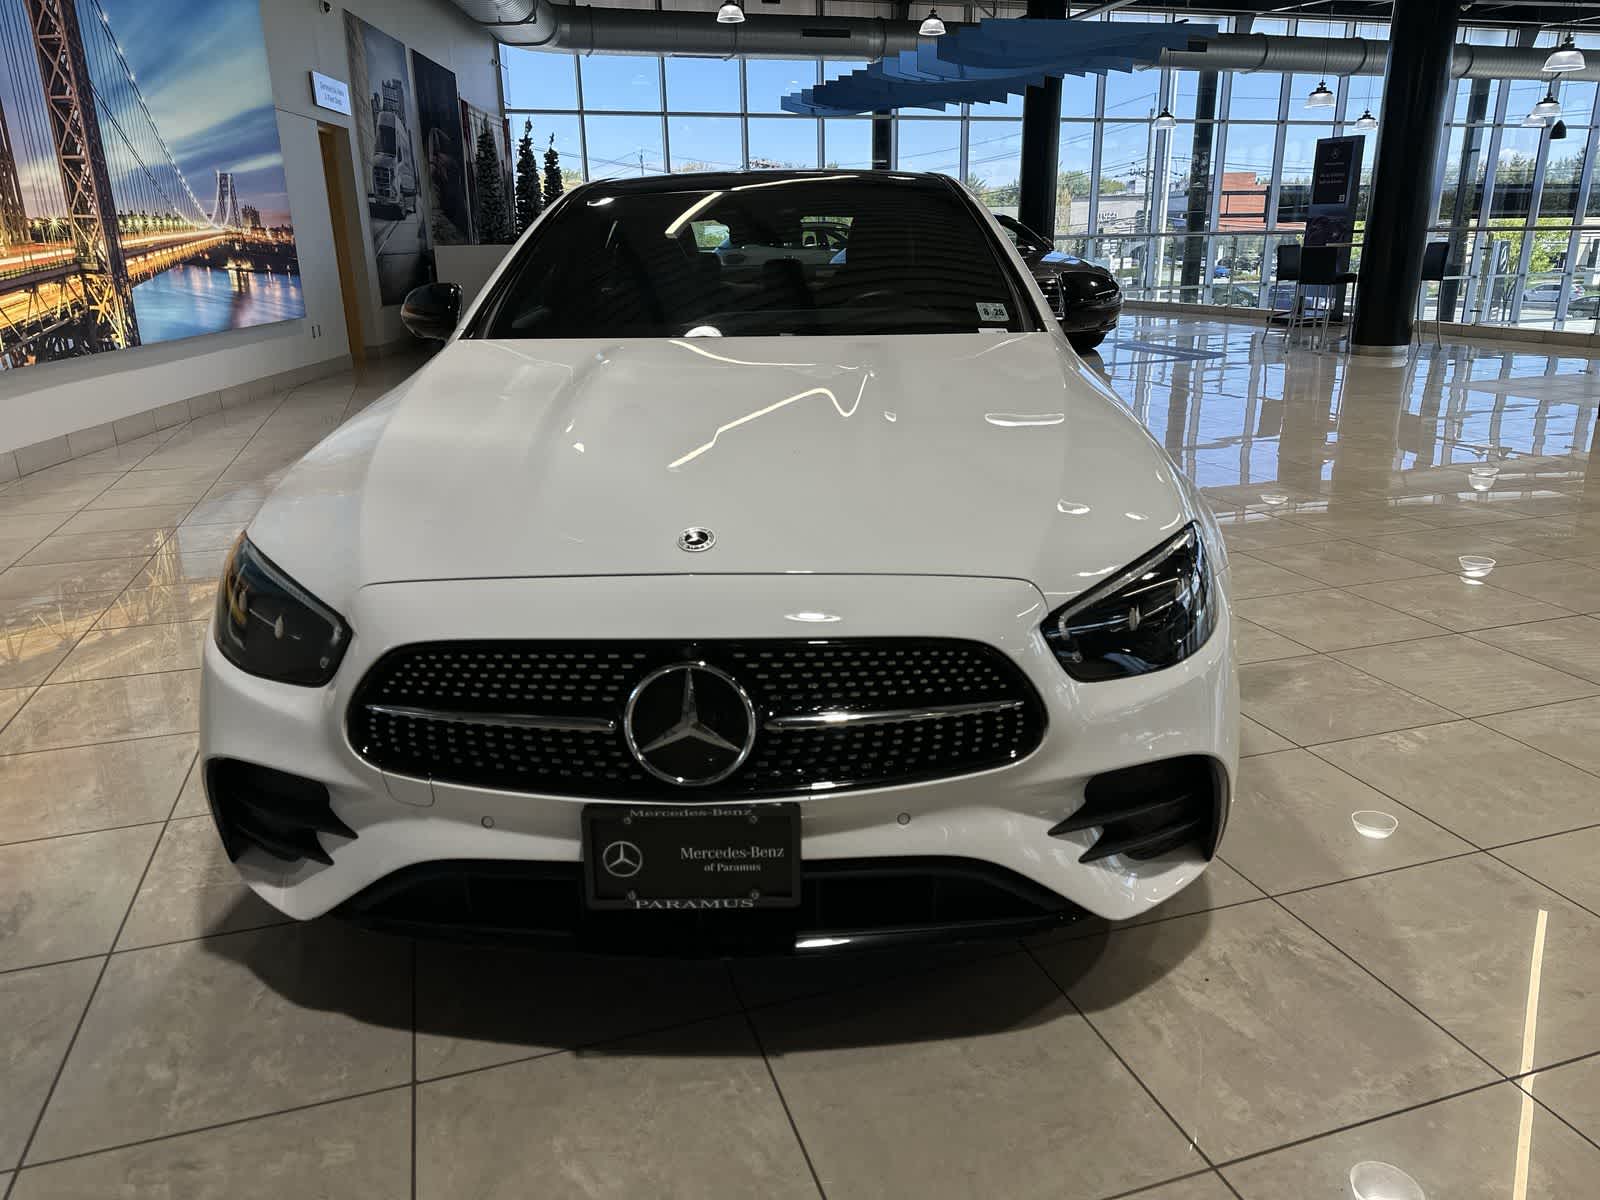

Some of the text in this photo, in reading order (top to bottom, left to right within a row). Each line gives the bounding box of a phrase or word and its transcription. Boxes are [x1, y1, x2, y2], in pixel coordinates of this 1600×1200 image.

[630, 808, 752, 817] Mercedes-Benz
[680, 846, 785, 860] Mercedes-Benz
[704, 863, 761, 872] of Paramus
[635, 899, 755, 909] PARAMUS
